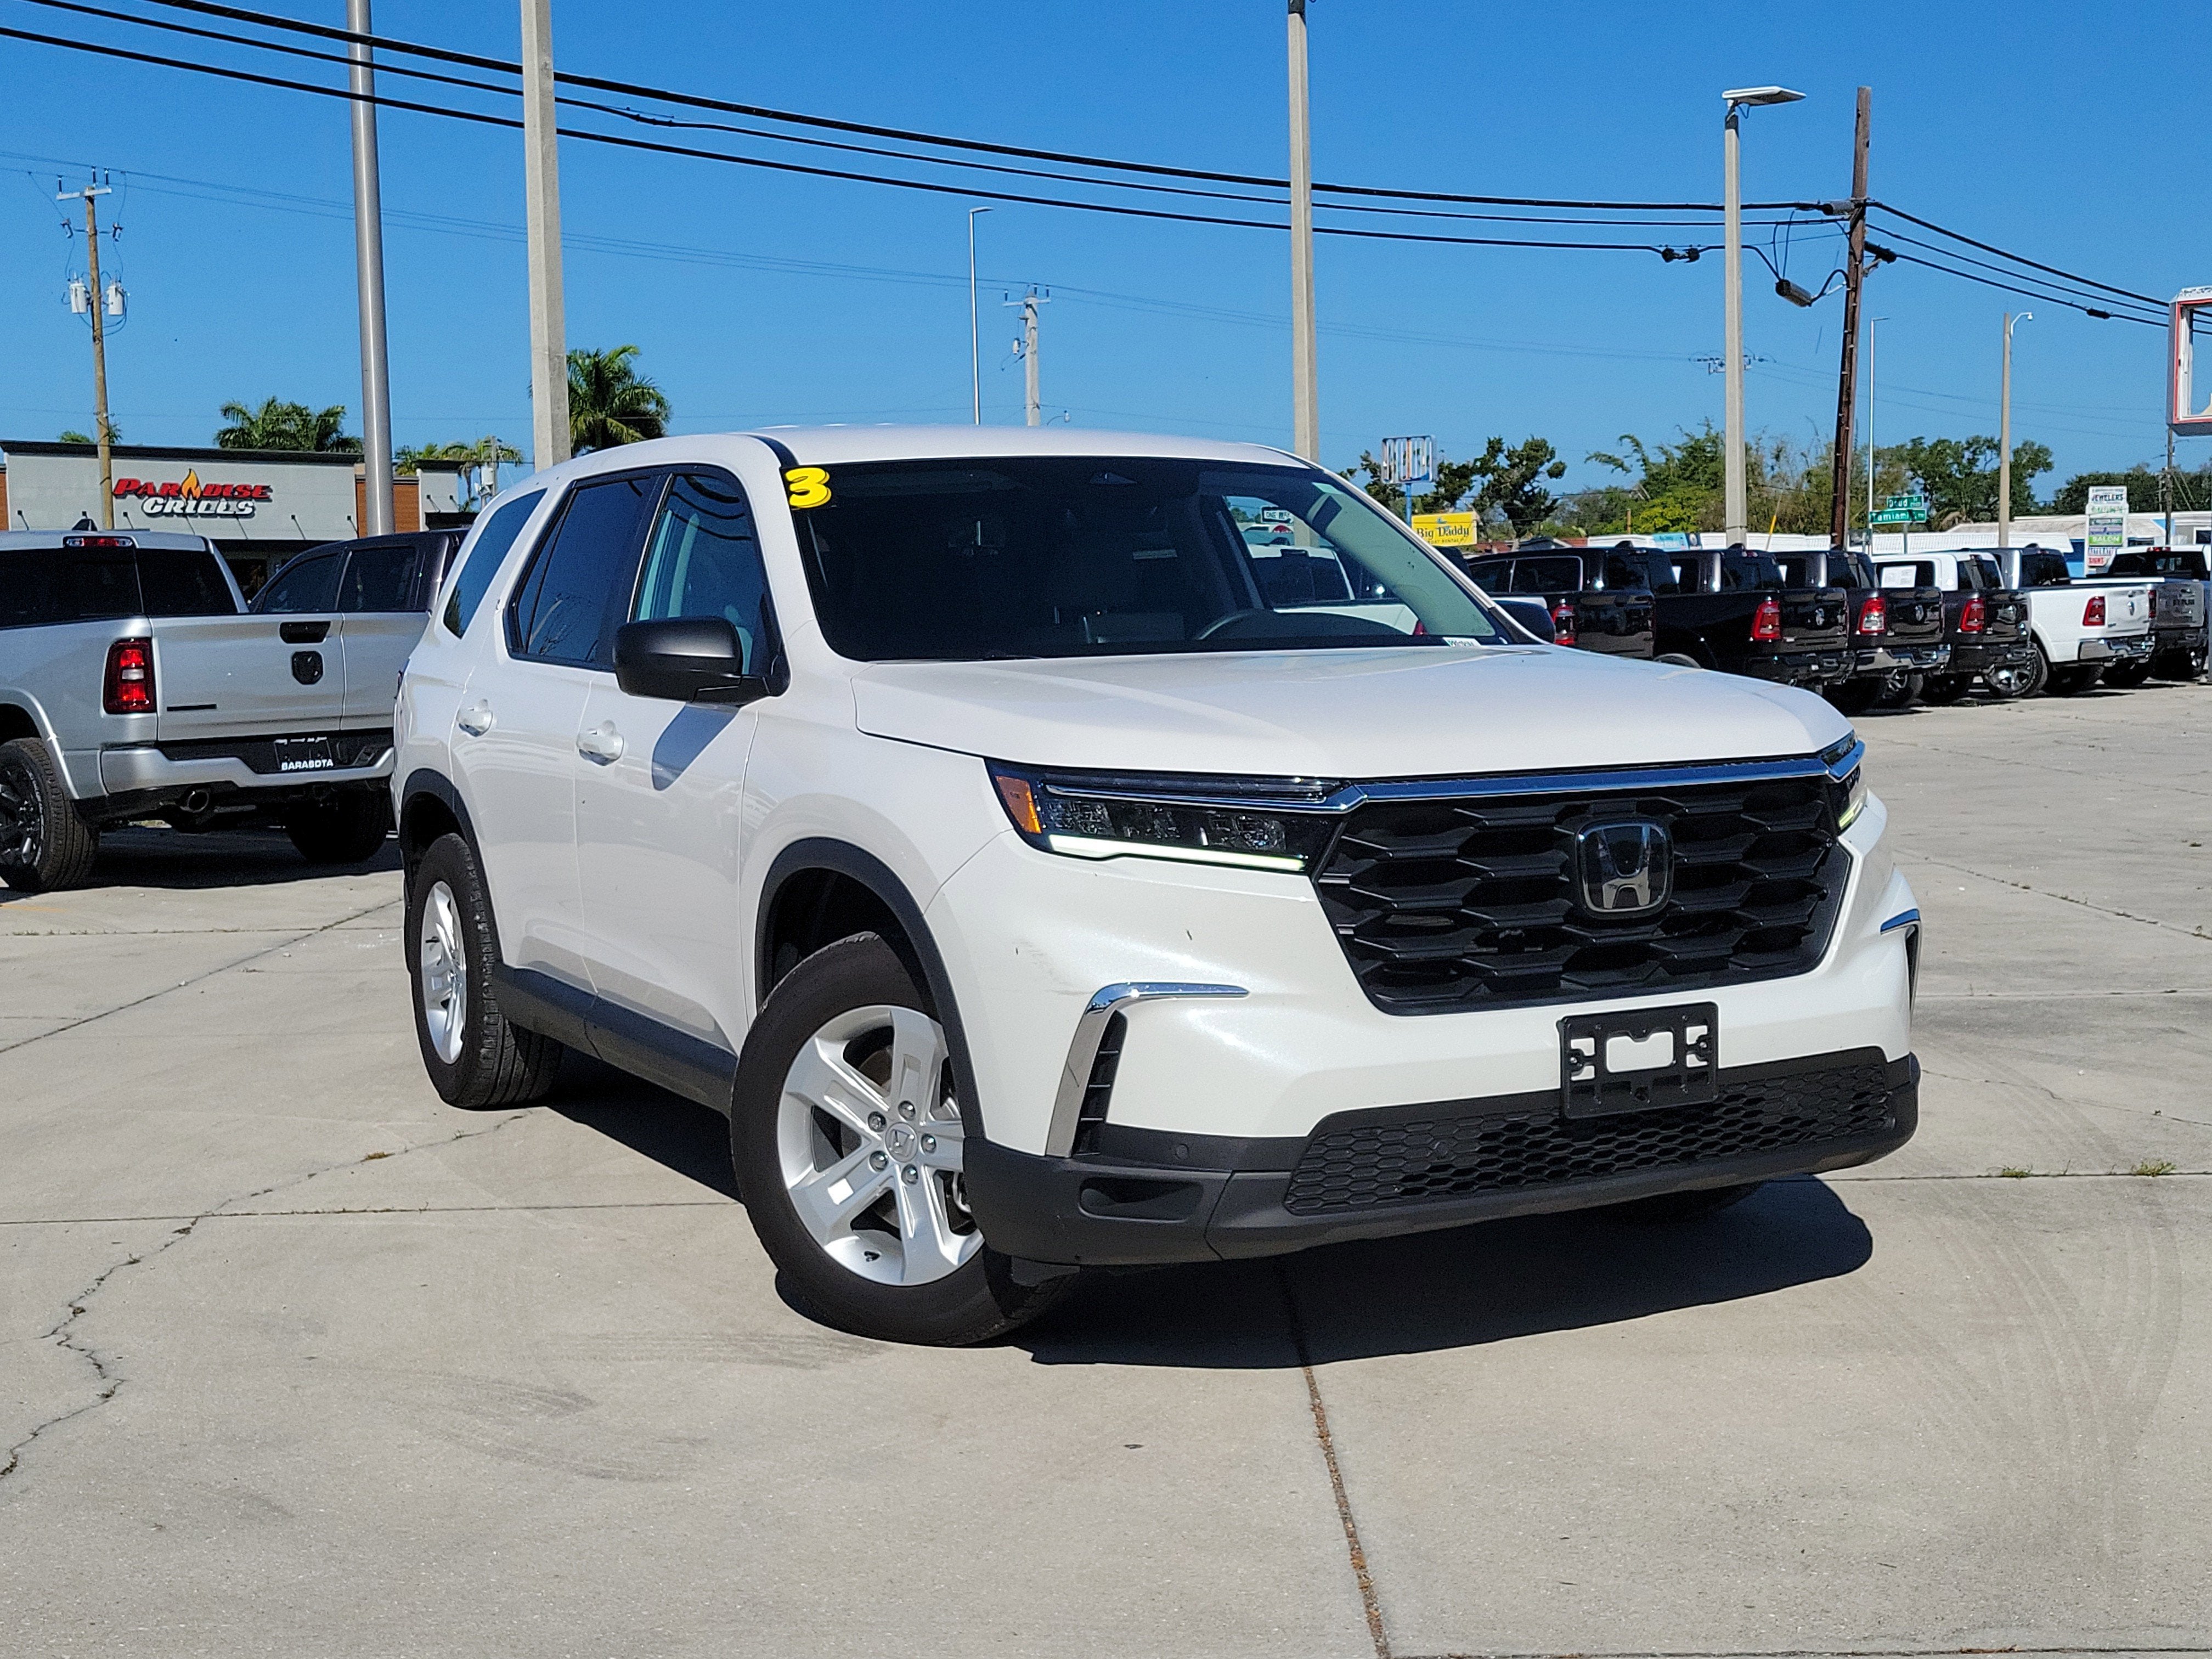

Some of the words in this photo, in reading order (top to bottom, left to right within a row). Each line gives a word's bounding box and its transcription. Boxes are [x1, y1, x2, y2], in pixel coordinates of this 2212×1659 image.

[112, 475, 273, 501] PARADISE
[785, 467, 831, 508] 3
[142, 496, 255, 517] GRILLS
[1417, 527, 1434, 539] Big
[1437, 525, 1470, 537] Daddy
